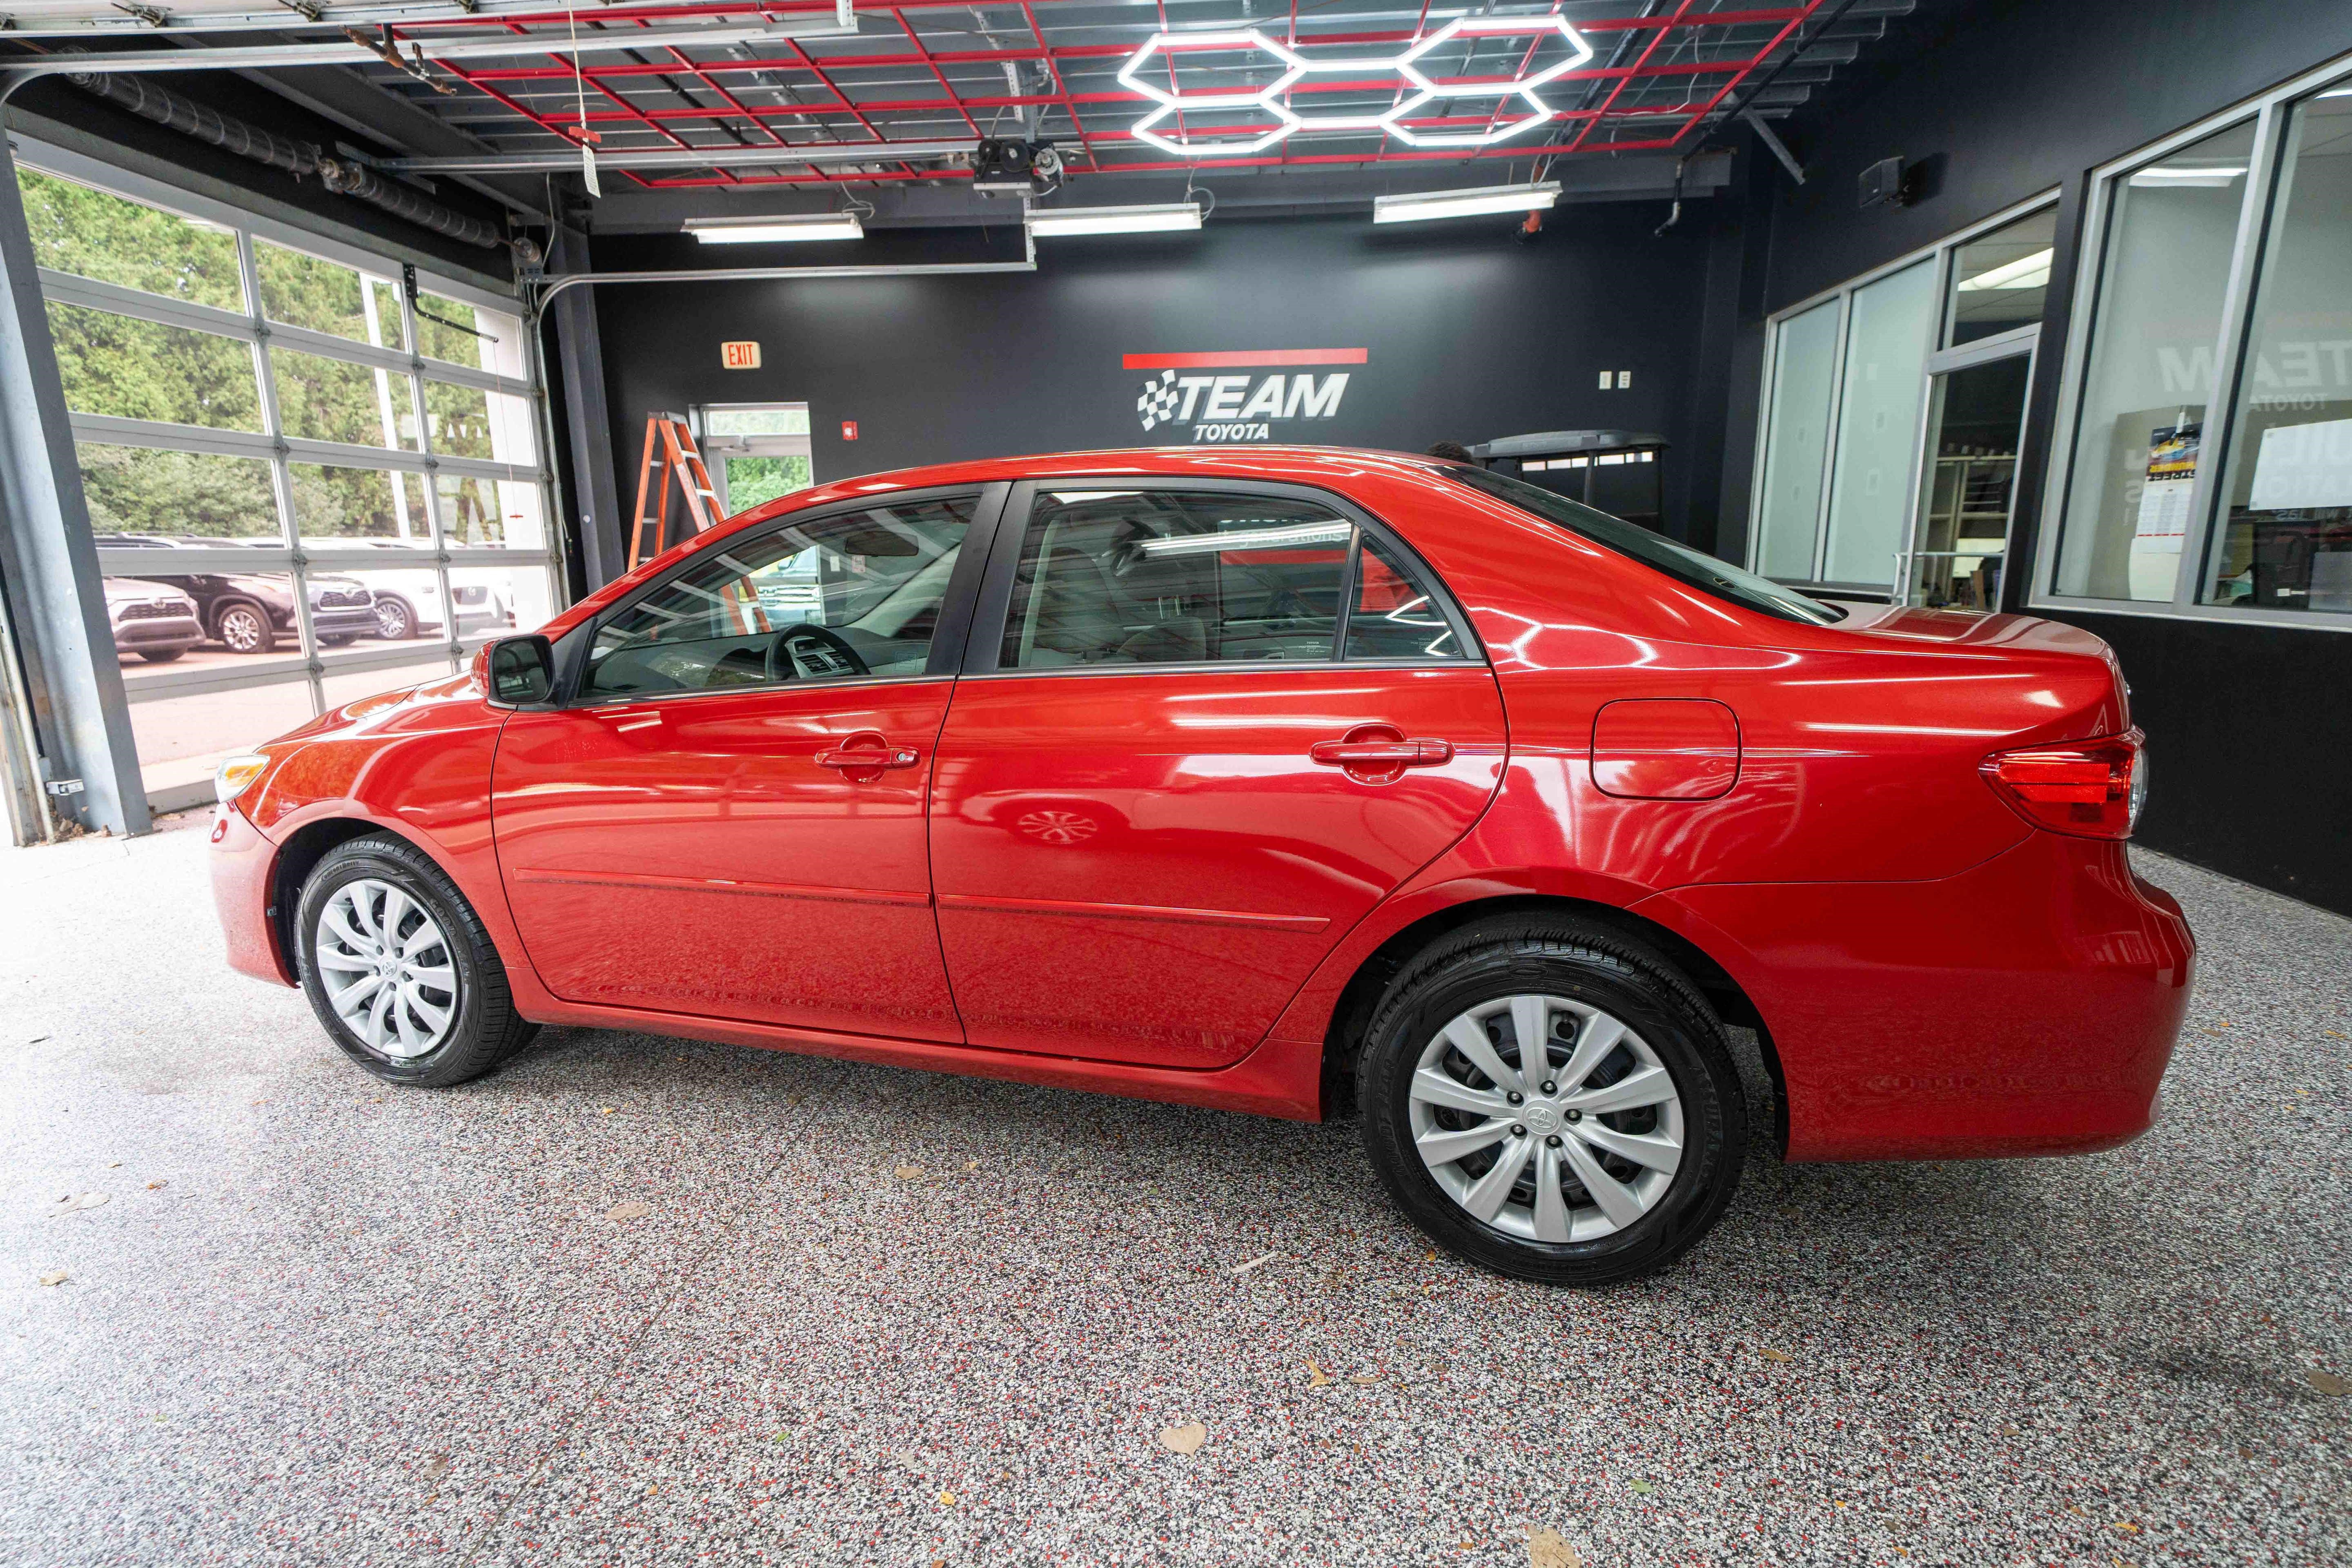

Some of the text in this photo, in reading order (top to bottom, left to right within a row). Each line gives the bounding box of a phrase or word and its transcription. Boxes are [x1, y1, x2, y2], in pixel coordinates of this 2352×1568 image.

[728, 344, 753, 365] EXIT
[1176, 373, 1350, 421] TEAM
[1194, 423, 1269, 441] TOYOTA
